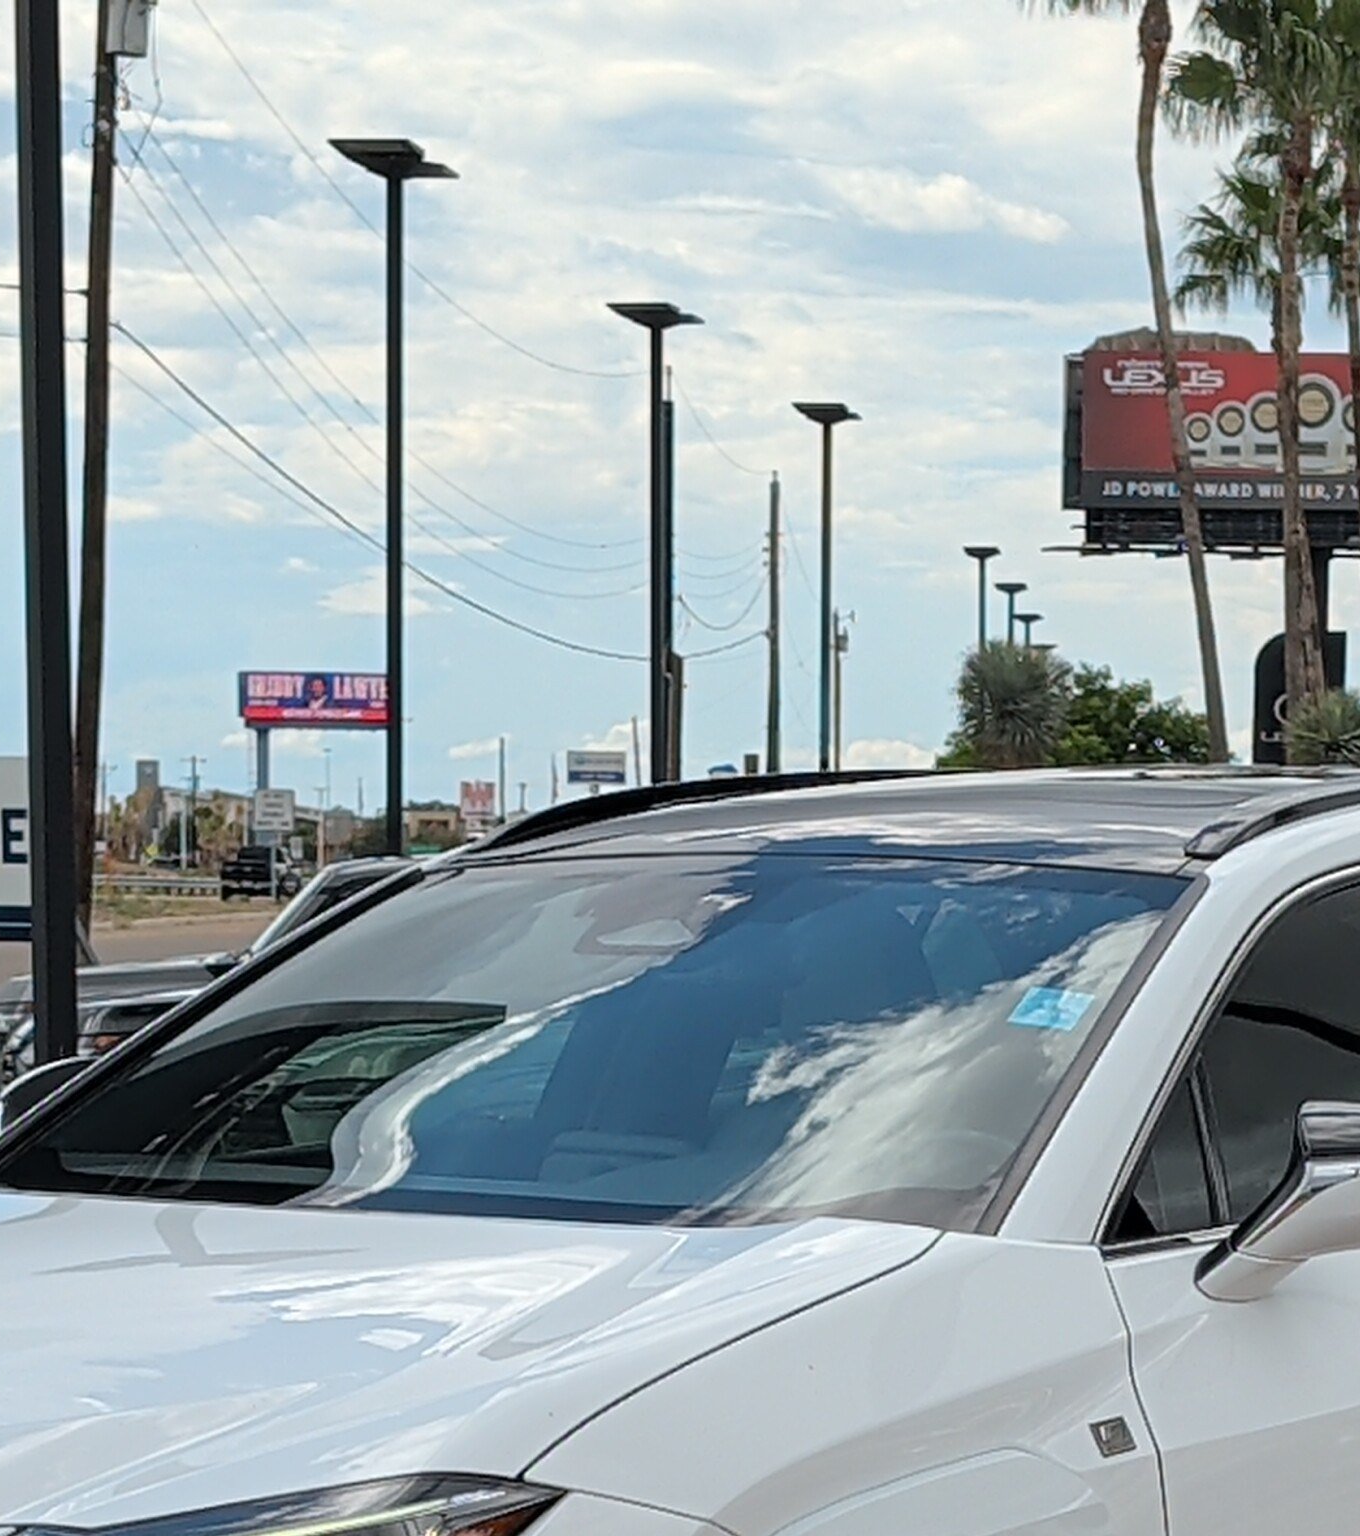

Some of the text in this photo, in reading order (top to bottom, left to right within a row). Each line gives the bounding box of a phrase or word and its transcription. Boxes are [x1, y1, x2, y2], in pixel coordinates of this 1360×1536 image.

[1126, 481, 1181, 498] POWE
[1193, 481, 1254, 498] AWARD
[1335, 485, 1345, 499] 7
